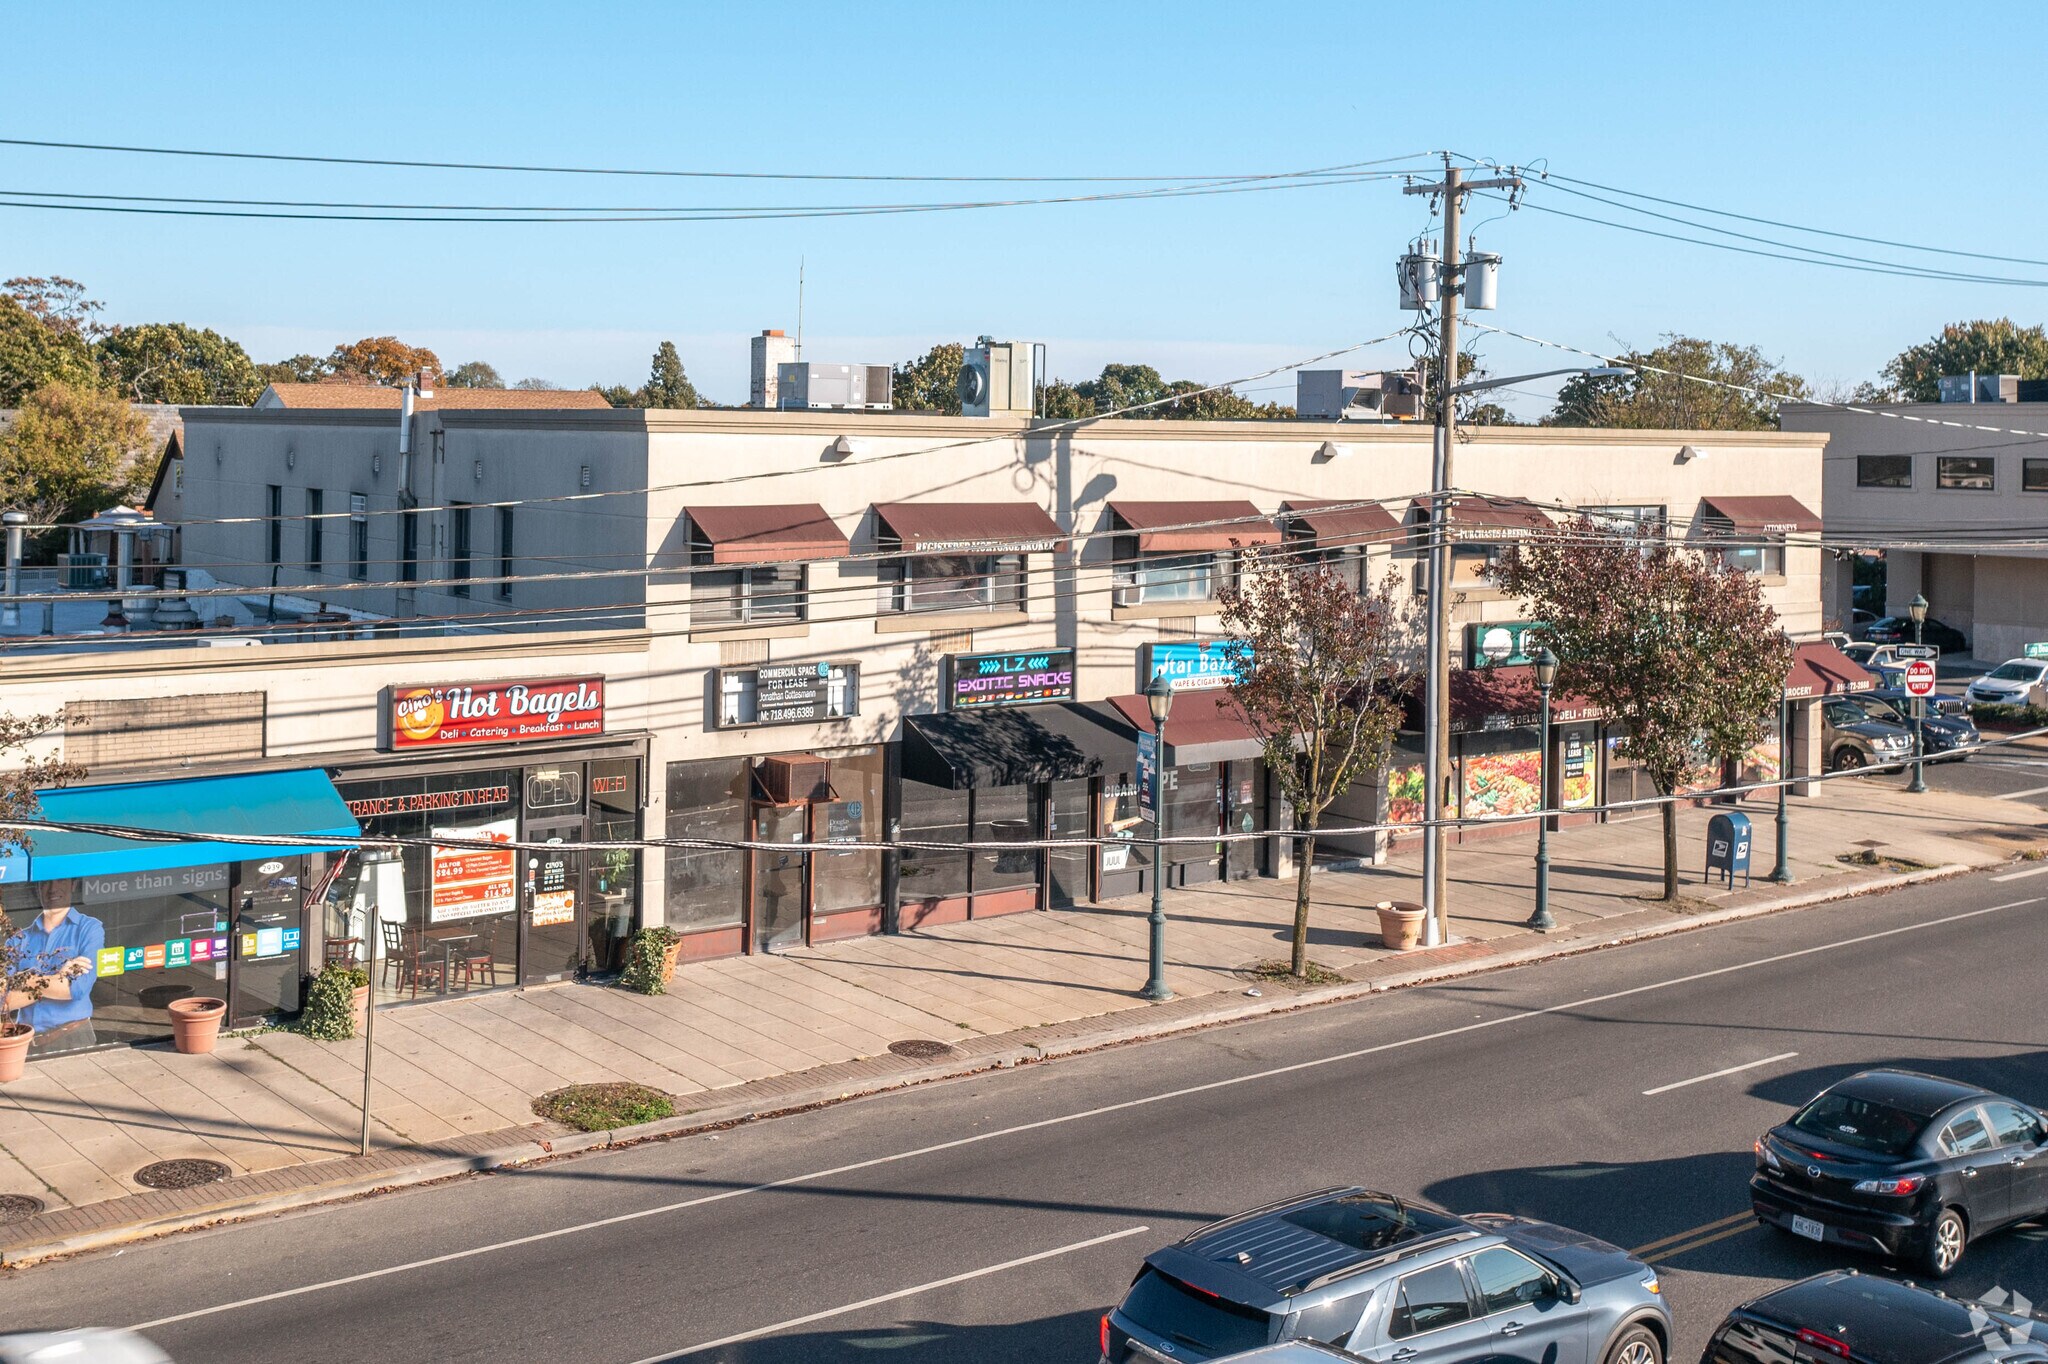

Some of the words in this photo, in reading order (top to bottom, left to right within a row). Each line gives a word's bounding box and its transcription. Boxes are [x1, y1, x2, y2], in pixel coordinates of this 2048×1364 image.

[1460, 529, 1500, 540] PURCHASES
[1763, 524, 1797, 532] ATTORNEYS
[916, 541, 971, 552] REGISTERED
[1003, 657, 1026, 672] LZ
[1156, 650, 1194, 675] Star
[760, 667, 797, 679] COMMERCIAL
[797, 666, 816, 677] SPACE
[768, 680, 783, 690] FOR
[784, 678, 808, 688] LEASE
[957, 676, 1014, 692] EXOTIC
[1018, 672, 1072, 687] SNACKS
[1174, 679, 1189, 687] VAPE
[760, 691, 784, 702] Jonathan
[784, 689, 816, 700] Gottesmann
[397, 688, 443, 717] Cino's
[446, 687, 500, 719] Hot
[506, 683, 600, 723] Bagels
[760, 710, 769, 722] M:
[770, 706, 814, 721] 718.496.6389
[1560, 709, 1576, 720] DELI
[440, 729, 459, 739] Deli
[470, 727, 509, 737] Catering
[519, 722, 564, 733] Breakfast
[574, 720, 599, 730] Lunch
[1571, 741, 1580, 749] FOR
[1568, 749, 1581, 757] LEASE
[593, 777, 626, 793] WI-FI
[1162, 770, 1178, 790] PE
[531, 776, 575, 804] OPEN
[397, 799, 405, 812] &
[410, 792, 459, 811] PARKING
[463, 790, 474, 805] IN
[478, 786, 509, 804] REAR
[262, 863, 281, 872] 2939
[545, 861, 564, 869] CINO'S
[1105, 855, 1121, 867] JUUL
[436, 867, 464, 878] $24.99
[85, 880, 128, 896] More
[135, 874, 173, 890] than
[182, 869, 227, 887] signs.
[484, 888, 511, 898] $14.99
